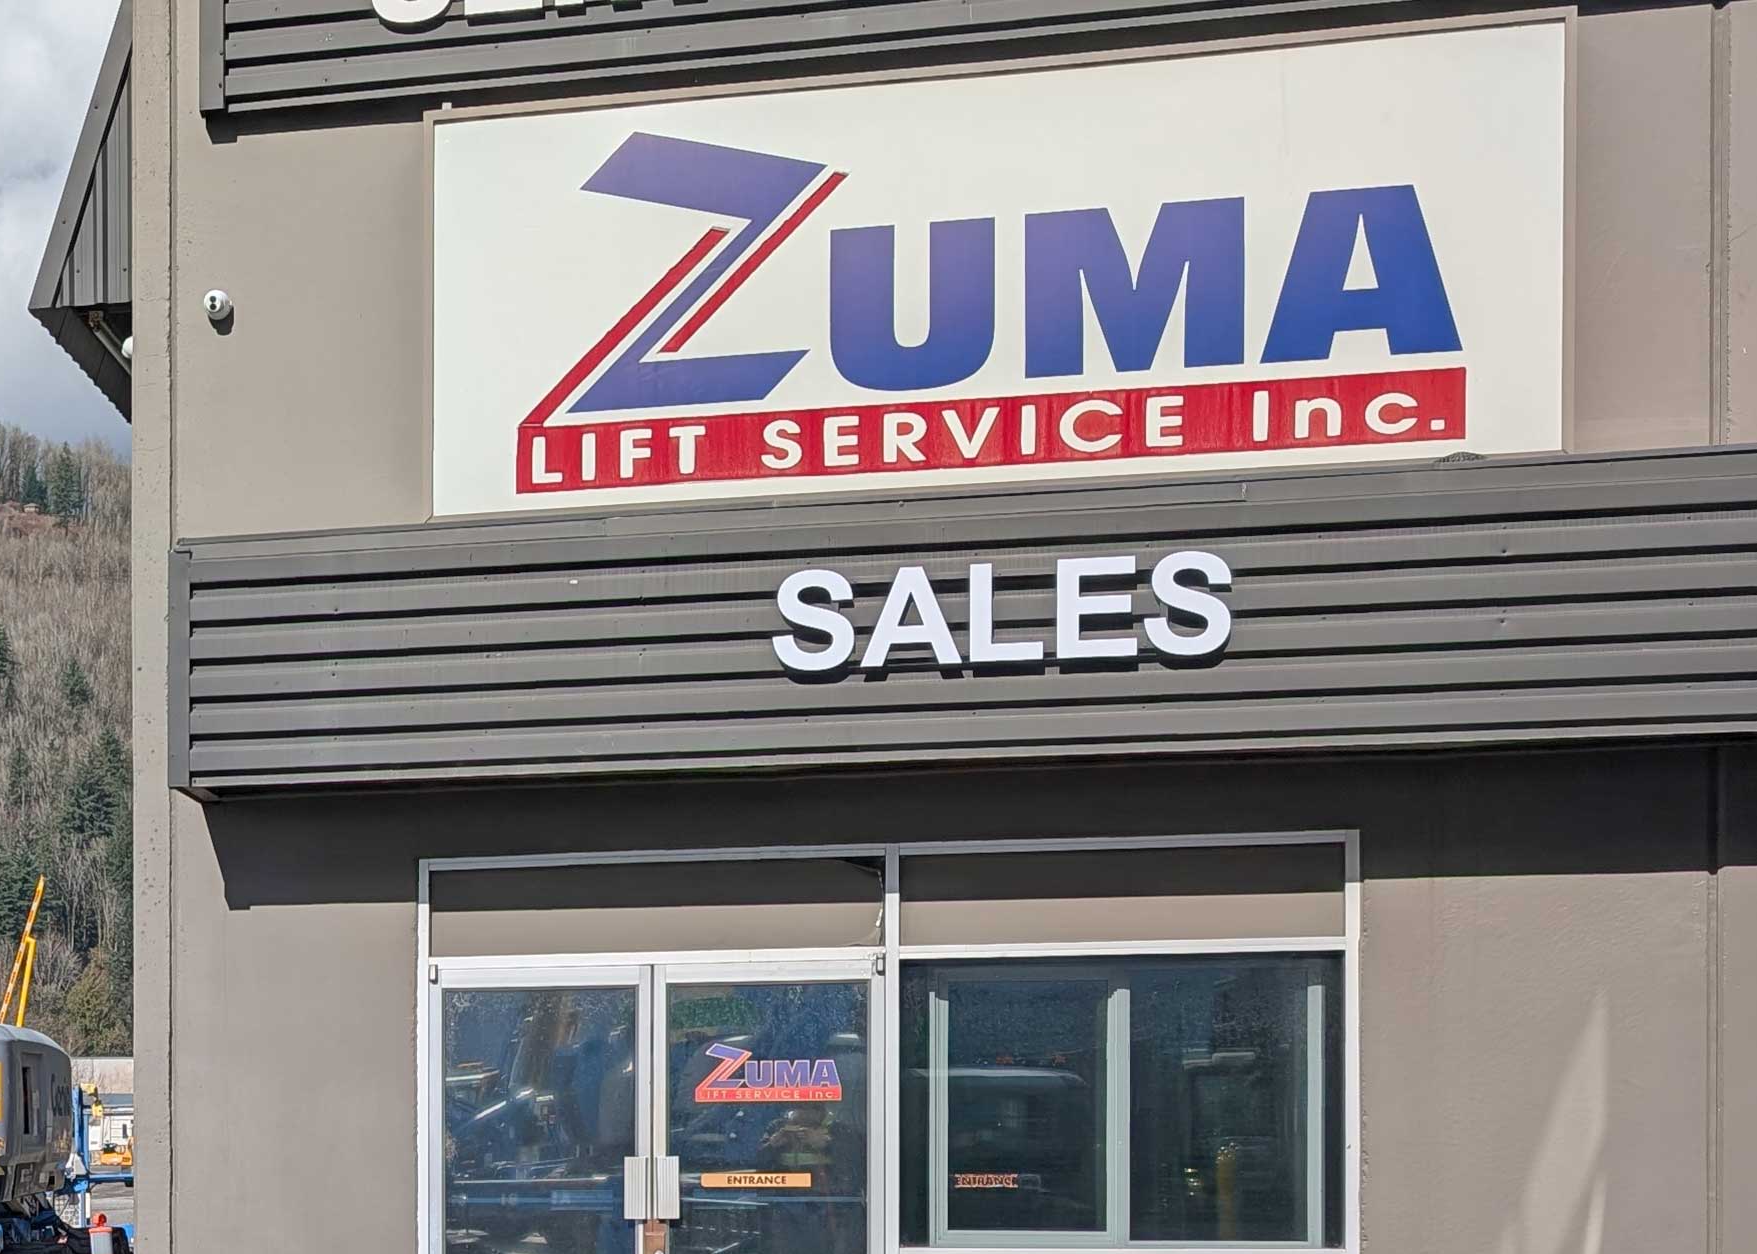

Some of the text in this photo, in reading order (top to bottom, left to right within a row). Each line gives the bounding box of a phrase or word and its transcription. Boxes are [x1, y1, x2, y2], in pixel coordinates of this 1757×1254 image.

[562, 131, 1463, 413] ZUMA
[530, 390, 1447, 485] LIFT SERVICE Inc.
[772, 550, 1233, 672] SALES
[699, 1089, 727, 1099] LIFT
[735, 1089, 800, 1099] SERVICE
[702, 1043, 841, 1089] ZUMA
[726, 1175, 787, 1185] ENTRANCE
